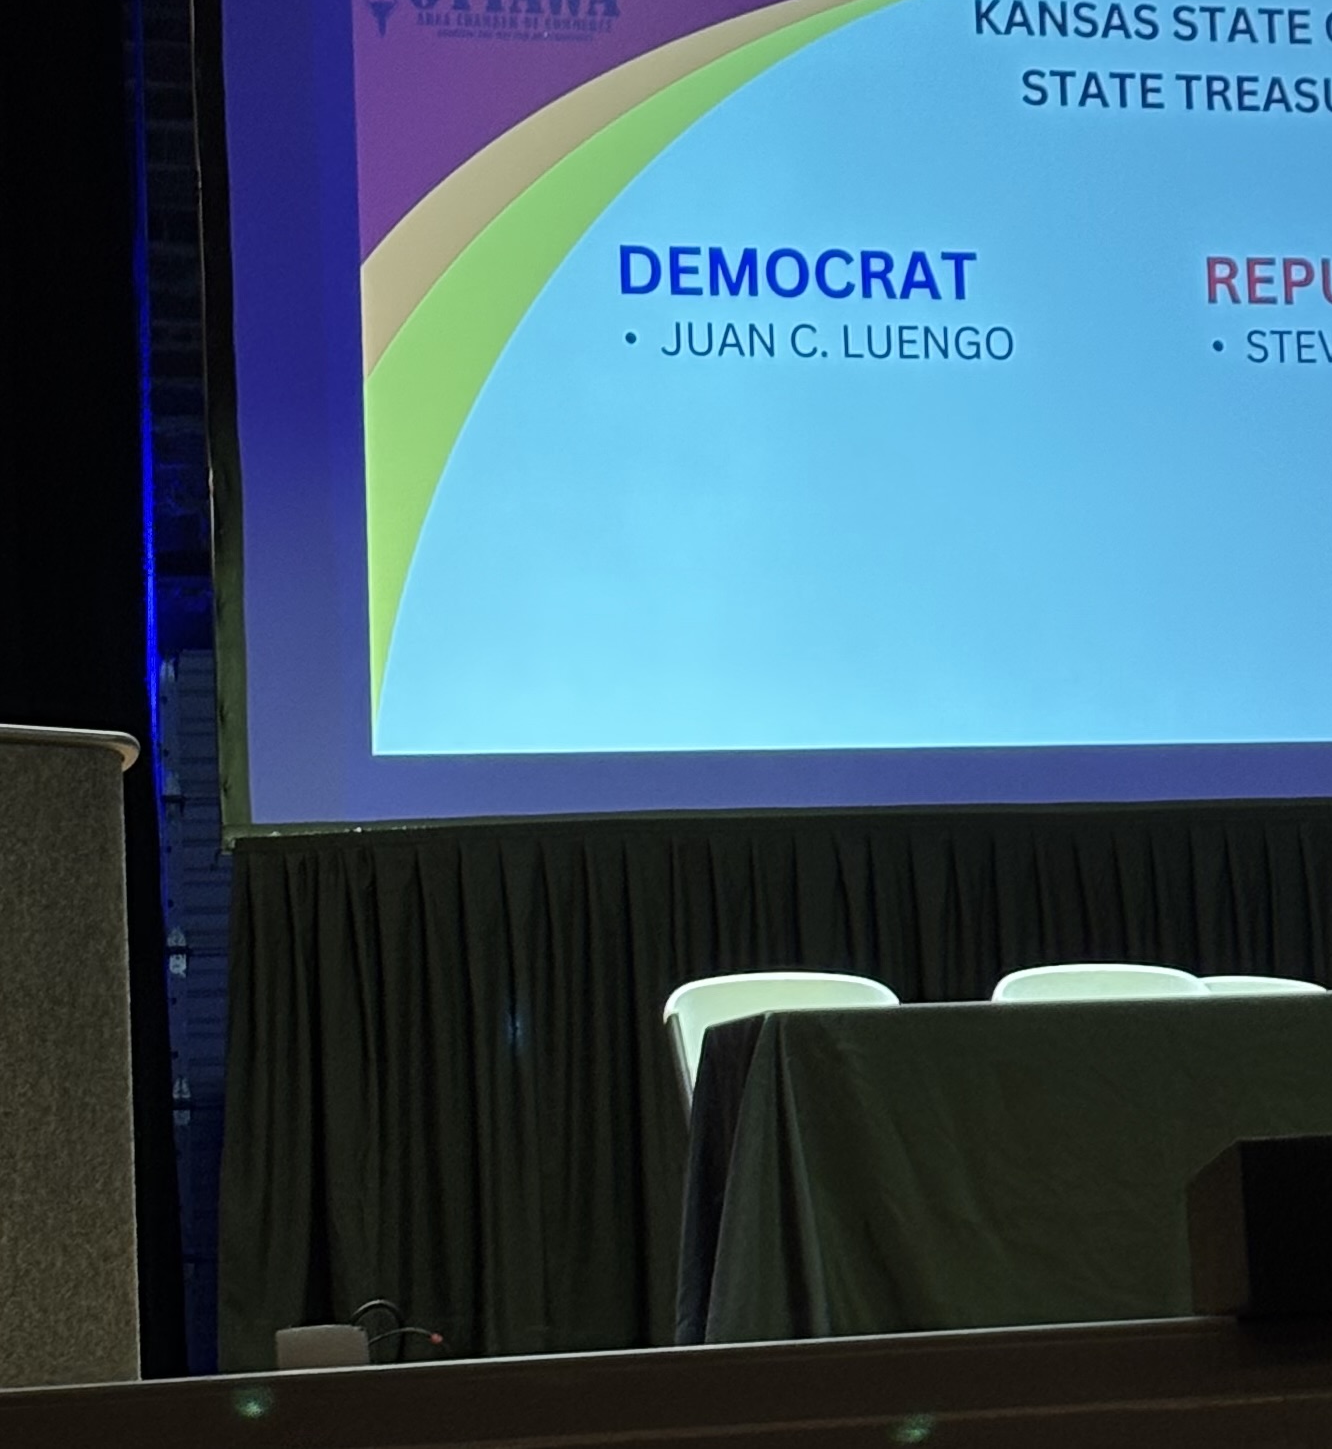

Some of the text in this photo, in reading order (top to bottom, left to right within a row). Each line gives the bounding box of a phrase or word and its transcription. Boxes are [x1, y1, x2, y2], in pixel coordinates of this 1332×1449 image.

[1172, 4, 1312, 45] STATE
[1021, 69, 1165, 110] STATE
[619, 245, 977, 301] DEMOCRAT
[660, 321, 1014, 360] JUAN C. LUENGO
